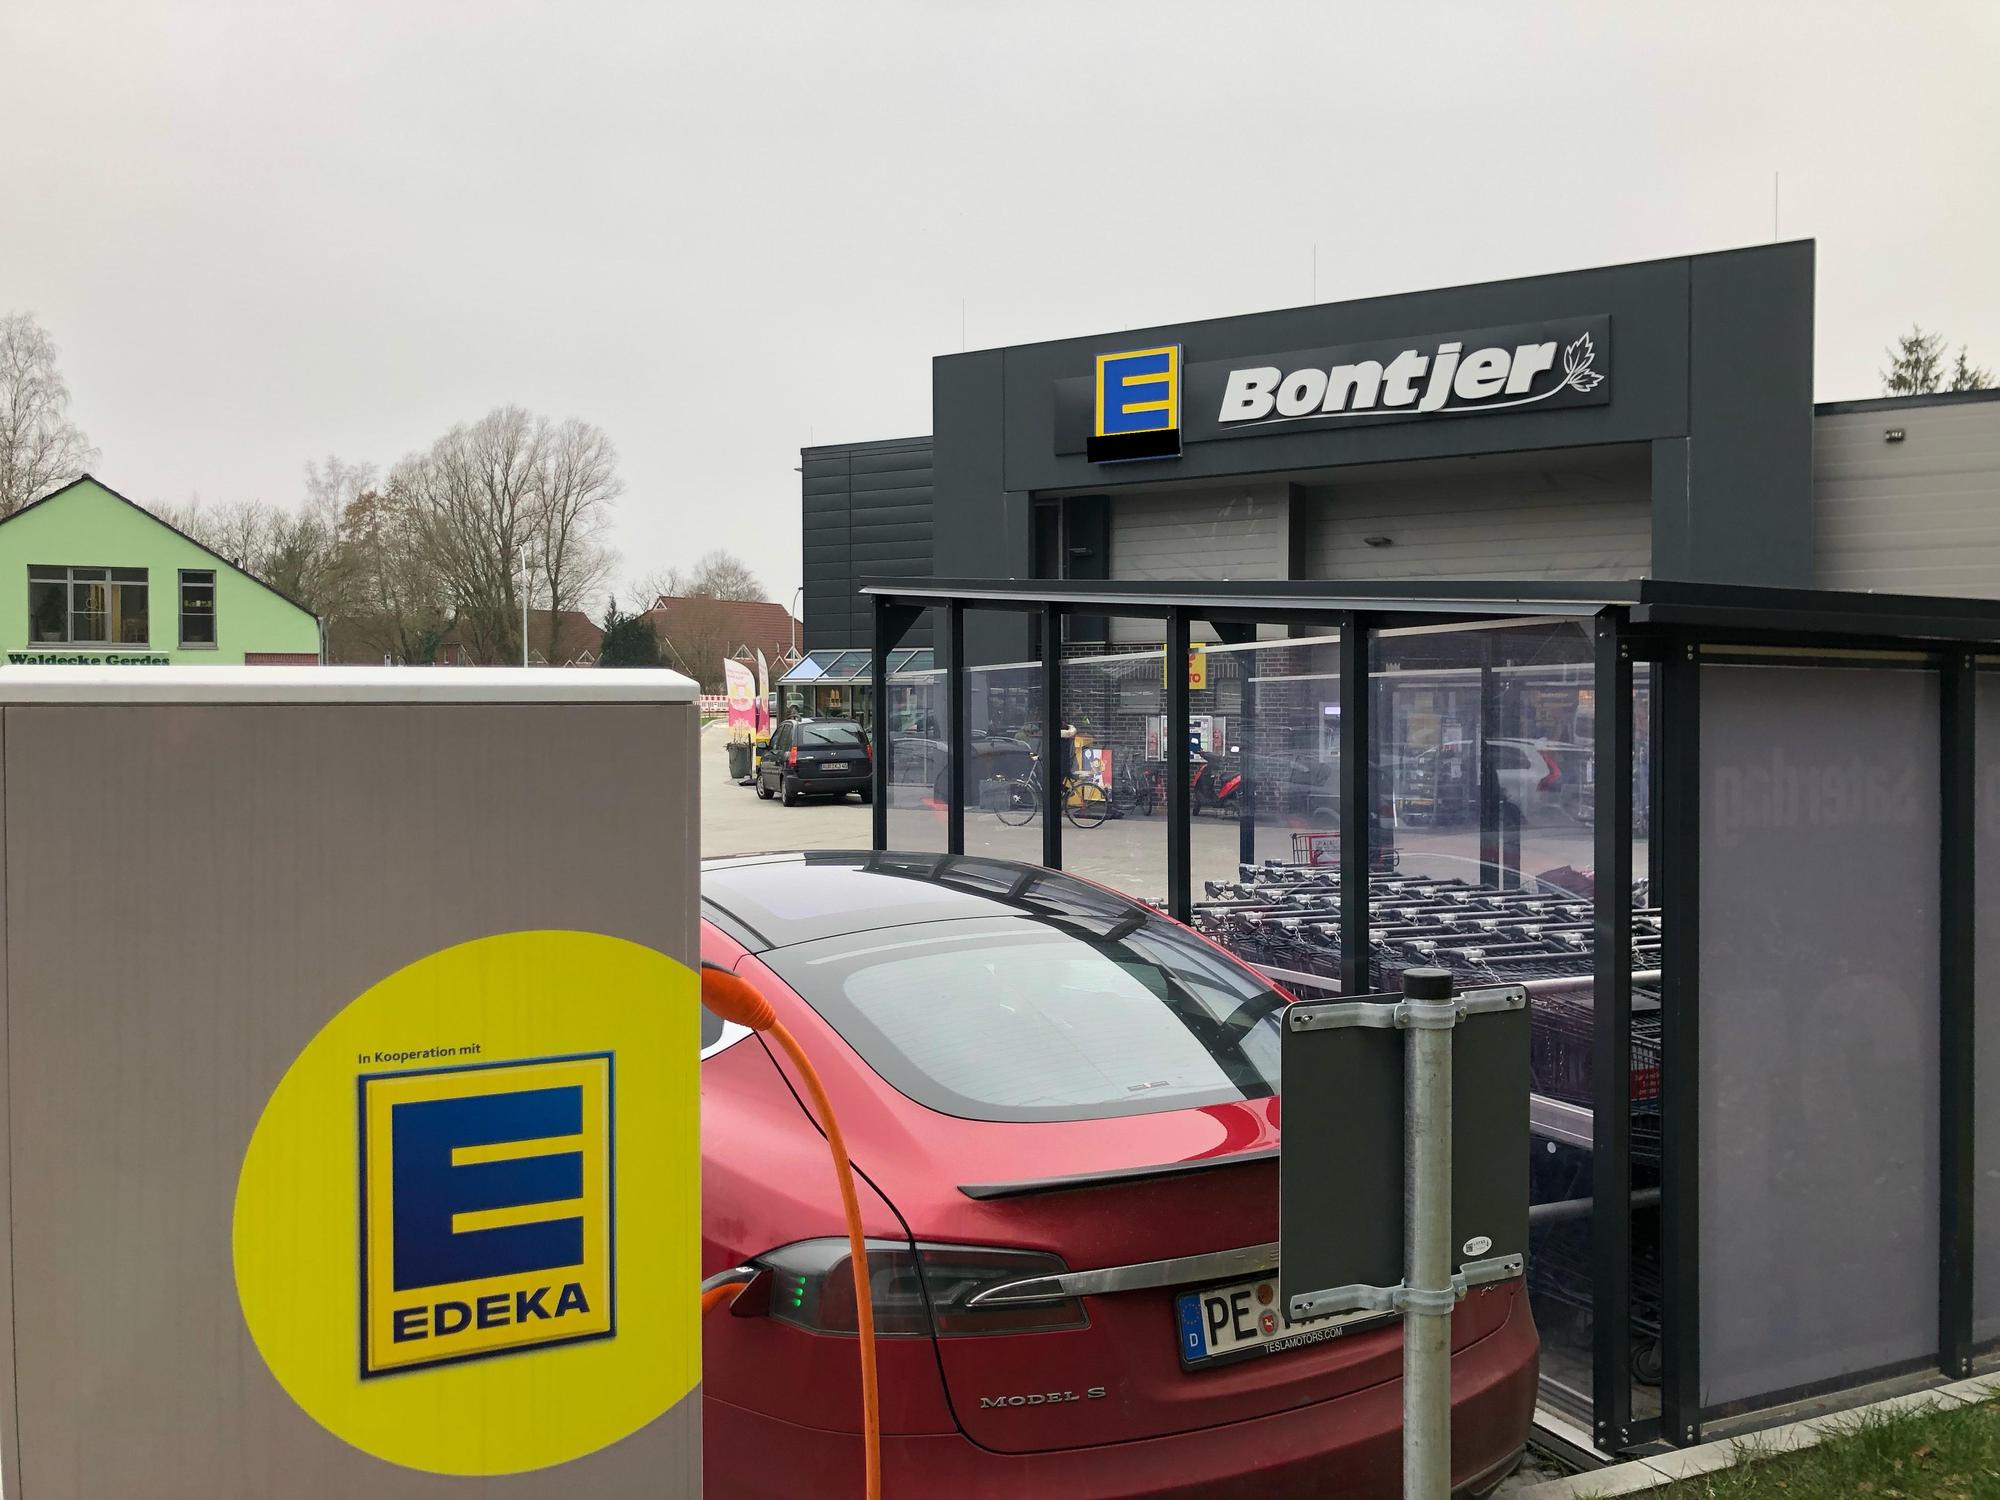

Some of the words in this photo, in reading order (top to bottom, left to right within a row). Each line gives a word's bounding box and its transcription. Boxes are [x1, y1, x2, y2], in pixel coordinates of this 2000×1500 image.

[1217, 339, 1559, 424] Bontjer
[8, 654, 101, 665] Waldecke
[105, 655, 170, 665] Gerdes
[358, 1053, 371, 1065] In
[375, 1045, 456, 1066] Kooperation
[459, 1043, 481, 1056] mit
[393, 1281, 590, 1344] EDEKA
[1190, 1333, 1199, 1347] D
[1264, 1327, 1343, 1353] TESLAMOTORS.COM
[979, 1391, 1080, 1409] MODEL
[1087, 1386, 1107, 1398] S
